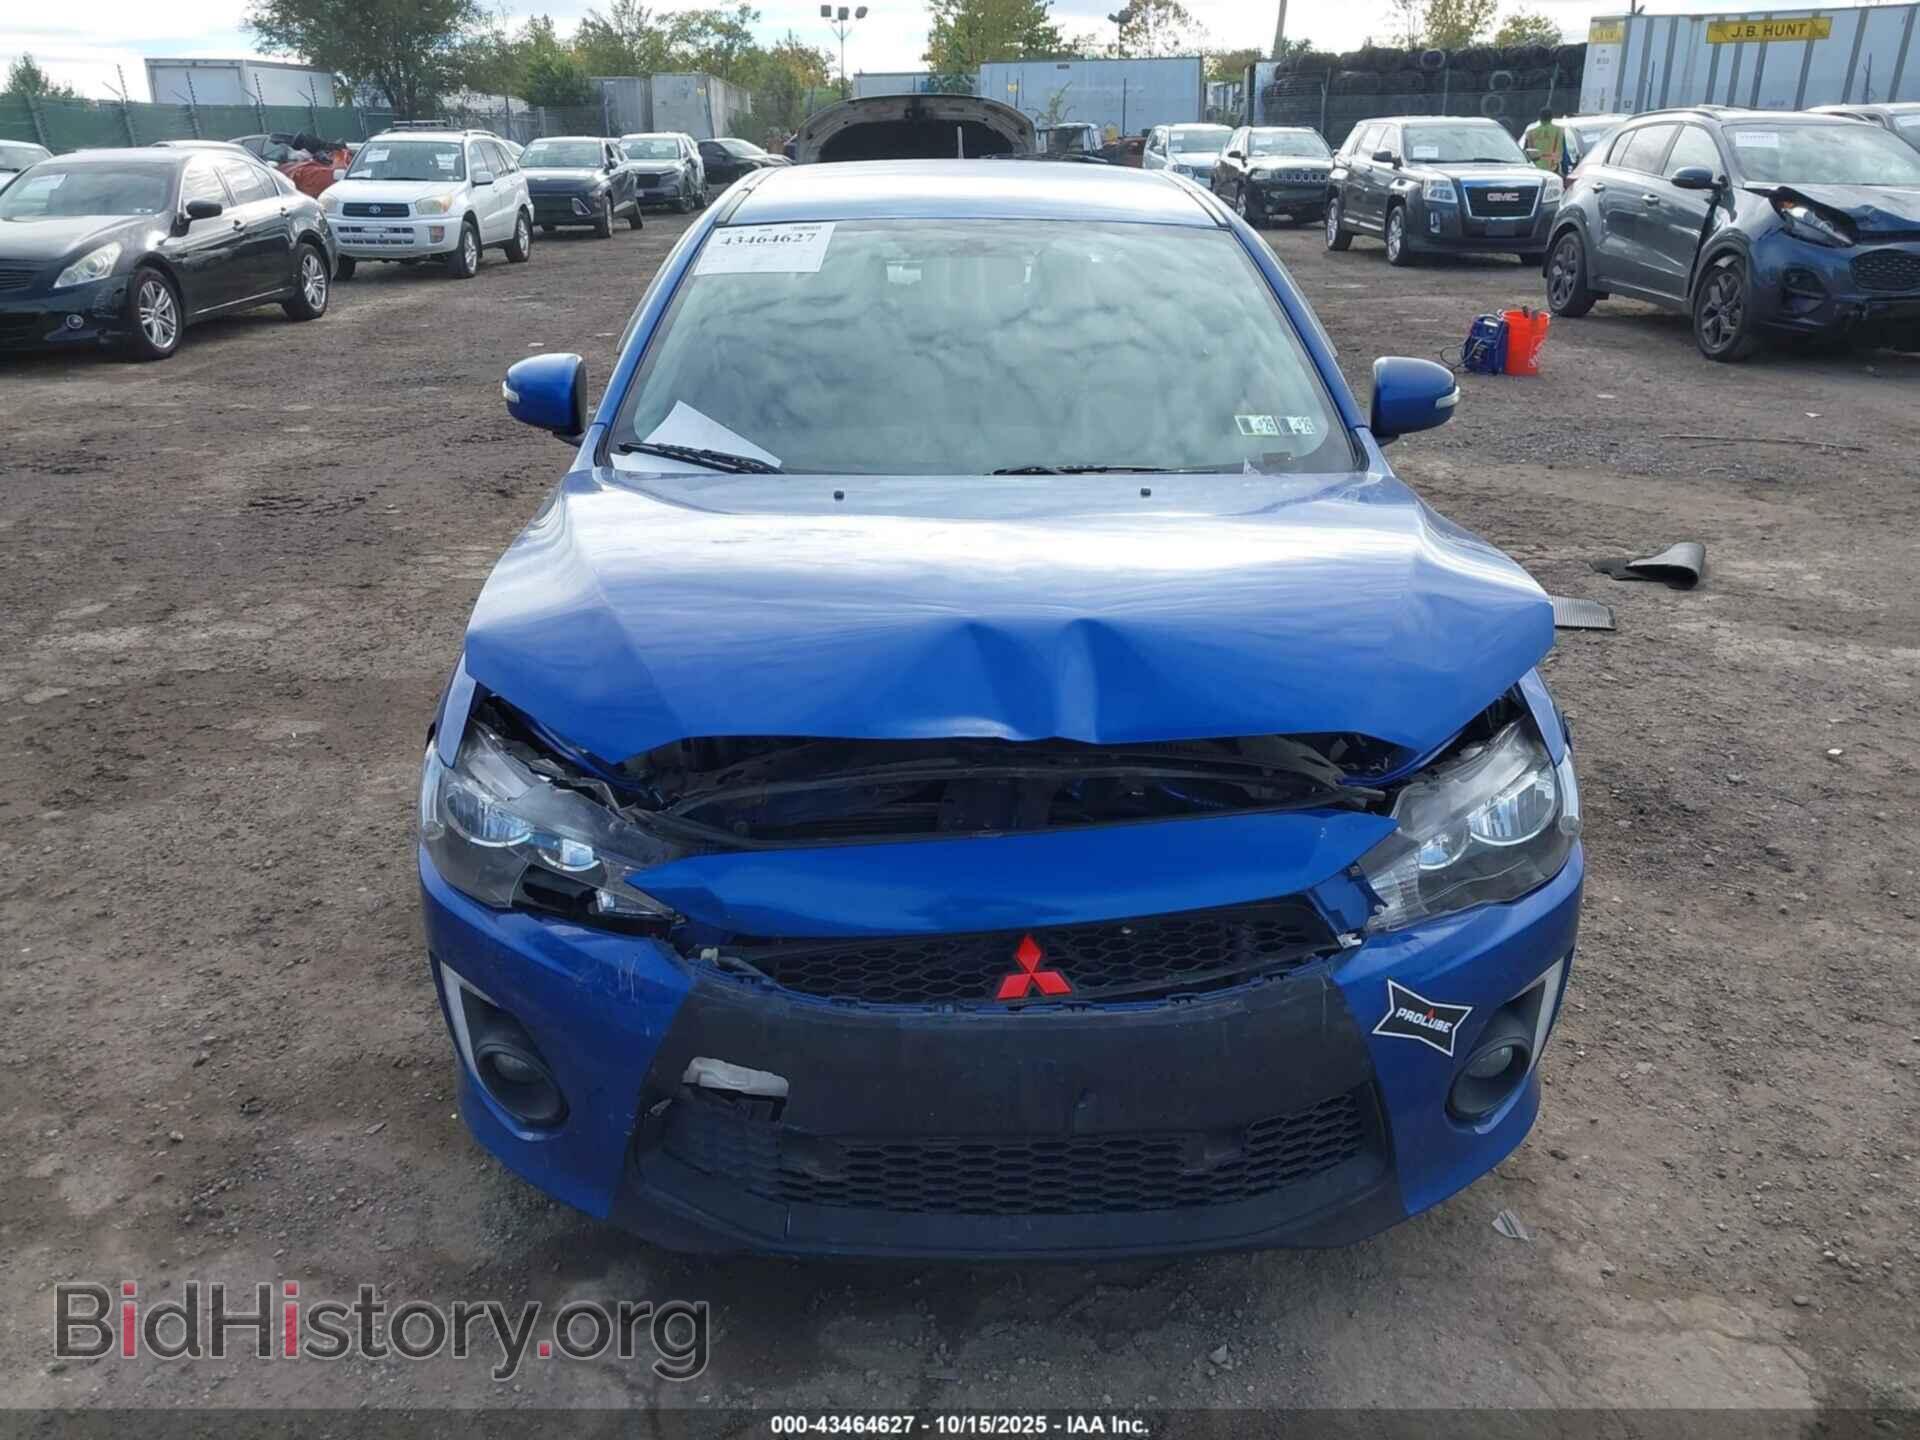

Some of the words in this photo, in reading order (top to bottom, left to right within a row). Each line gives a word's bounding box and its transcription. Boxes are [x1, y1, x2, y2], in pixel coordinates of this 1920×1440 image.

[1762, 23, 1807, 37] HUNT
[1487, 192, 1519, 202] GMC
[720, 231, 817, 246] 43464627
[1395, 1007, 1453, 1034] PROLUBE
